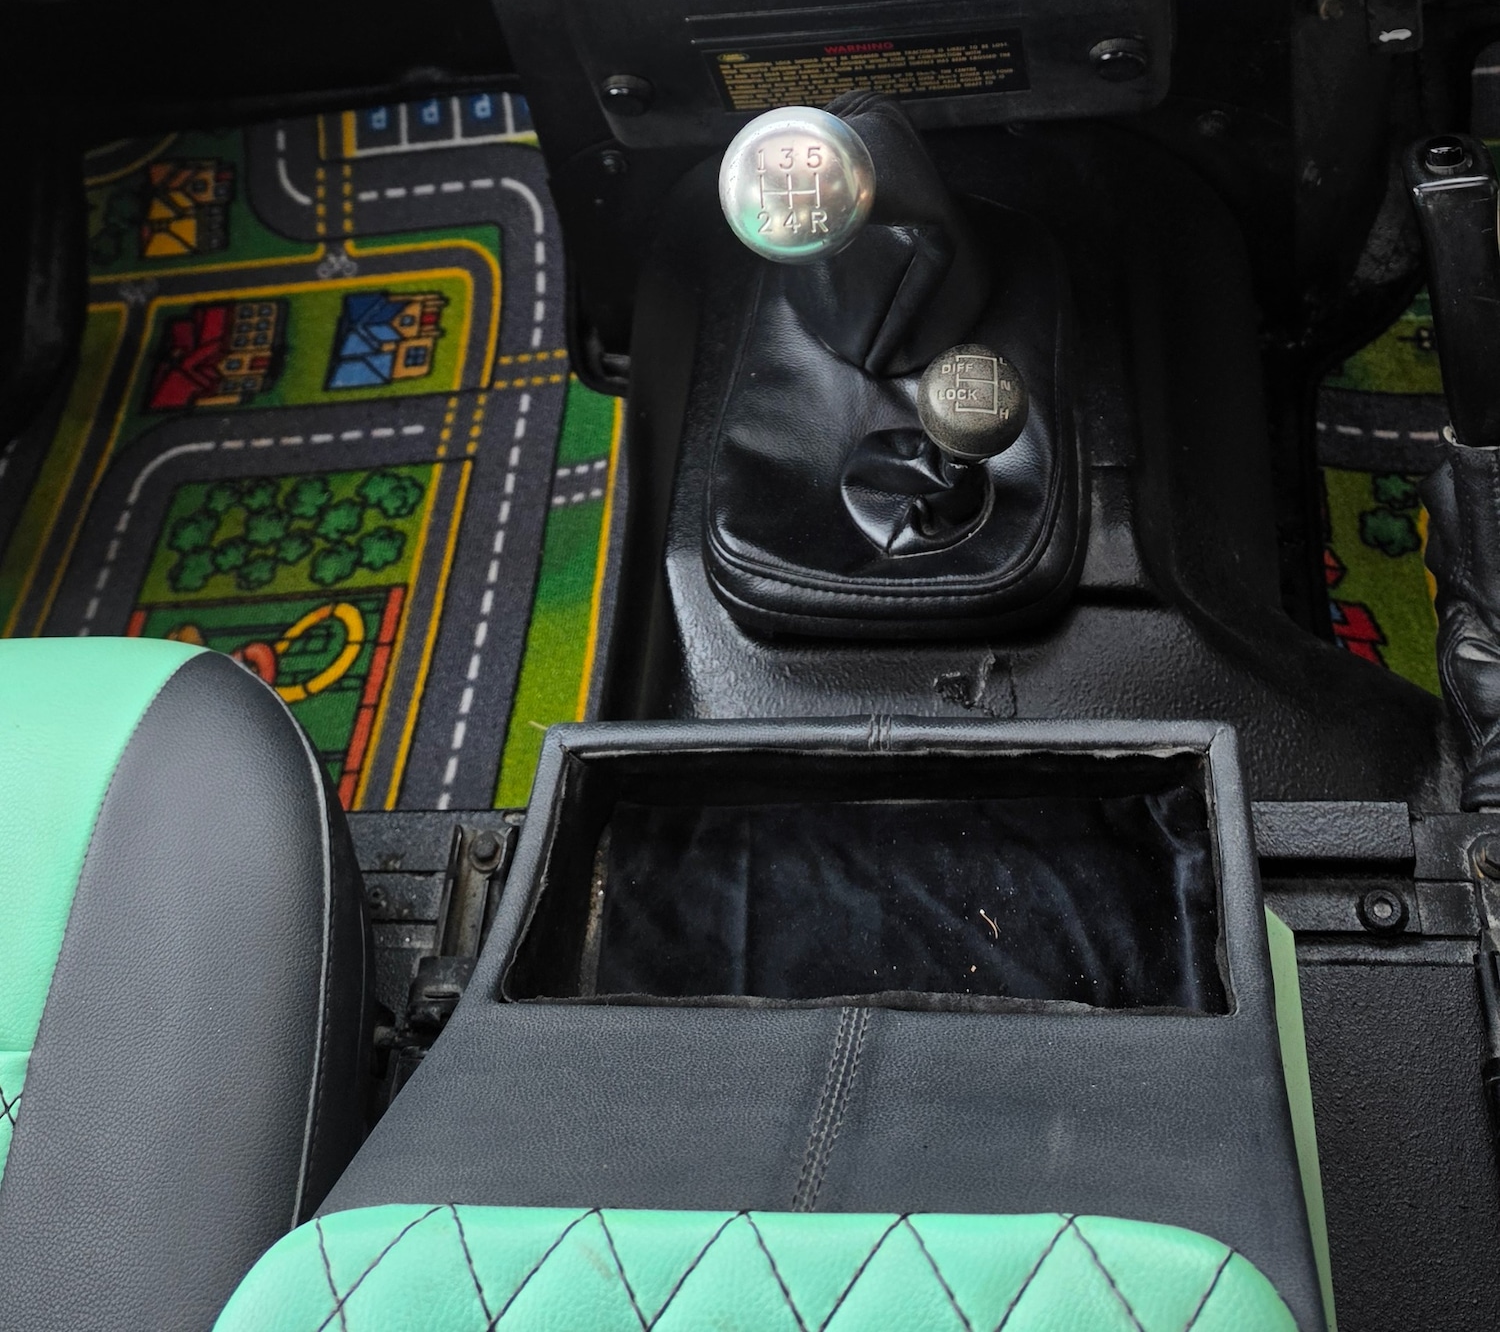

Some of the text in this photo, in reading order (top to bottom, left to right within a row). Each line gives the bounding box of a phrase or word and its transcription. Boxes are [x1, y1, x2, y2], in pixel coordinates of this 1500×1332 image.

[824, 42, 894, 54] WARNING
[757, 146, 823, 173] 1 3 5
[756, 211, 829, 235] 2 4 R
[941, 363, 974, 374] DIFF
[1001, 380, 1011, 391] N
[938, 388, 977, 400] LOCK
[999, 408, 1009, 420] H
